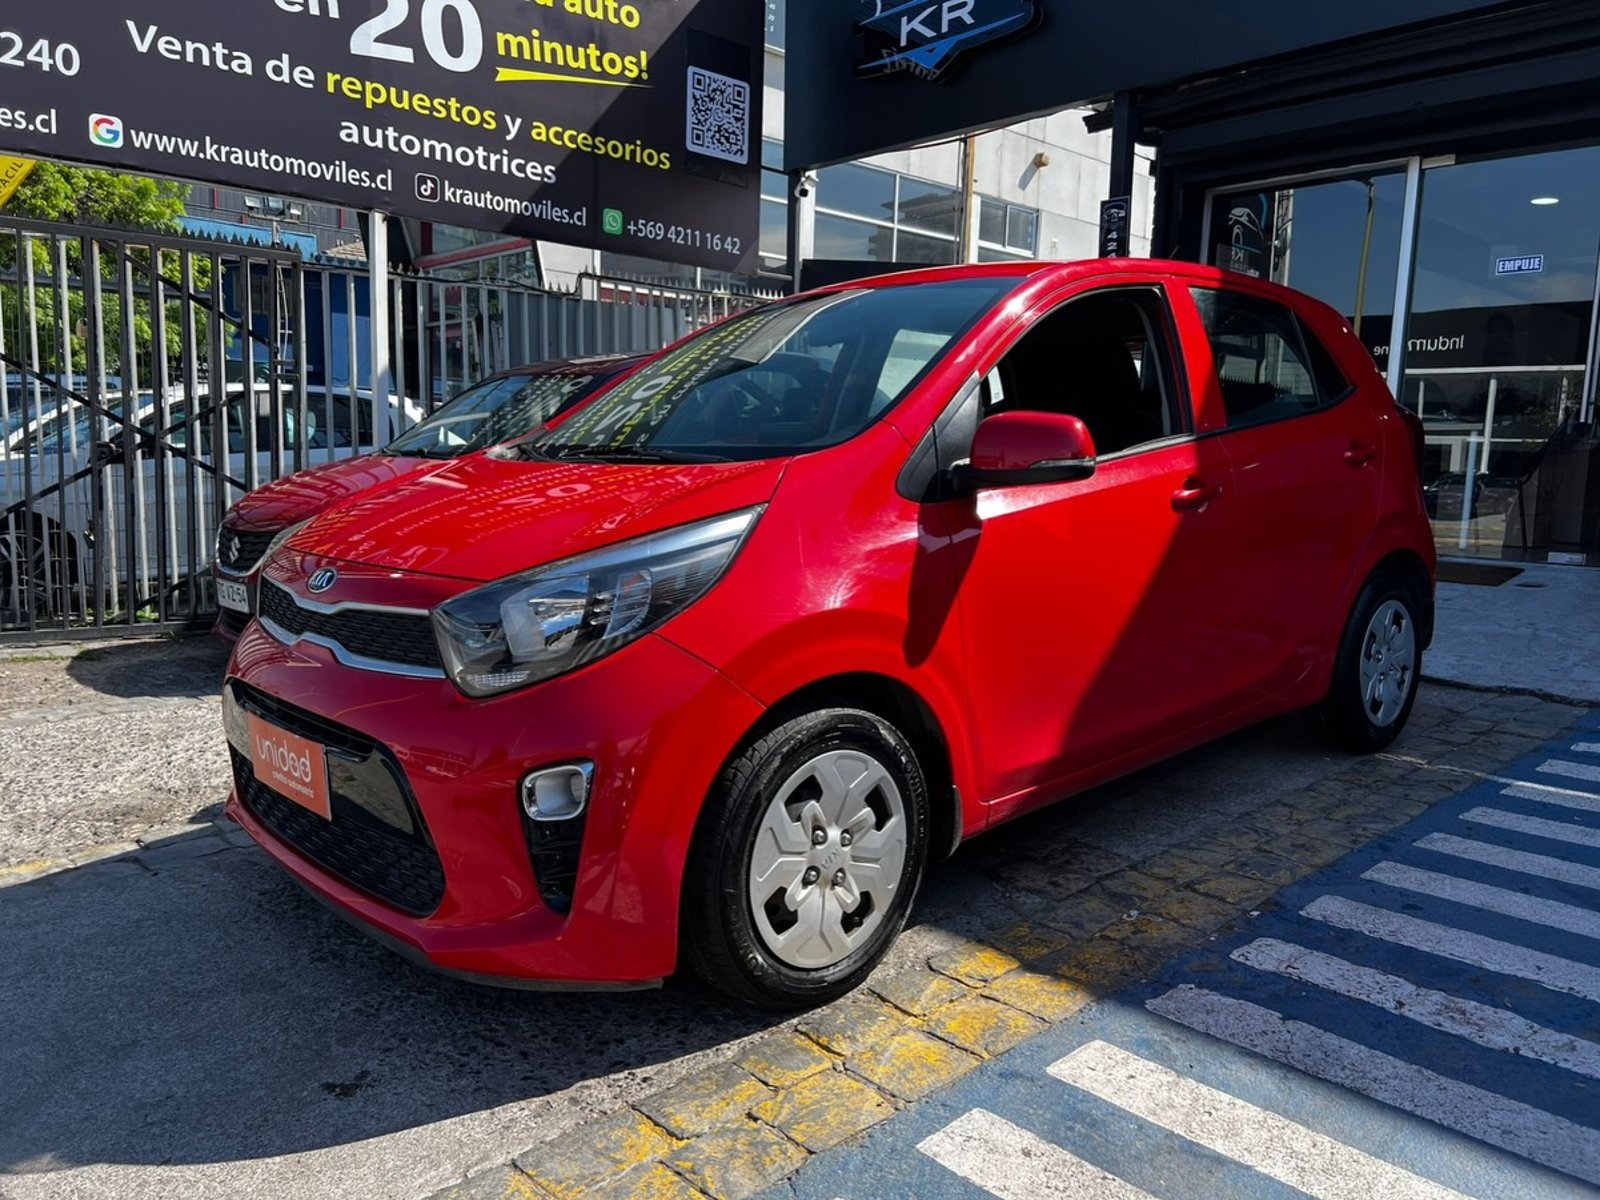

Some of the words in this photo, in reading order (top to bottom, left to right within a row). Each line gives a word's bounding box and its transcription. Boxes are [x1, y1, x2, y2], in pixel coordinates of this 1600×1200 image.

[350, 0, 483, 72] 20
[564, 0, 641, 28] auto
[899, 0, 975, 47] KR
[496, 29, 649, 80] minutos!
[126, 20, 252, 76] Venta
[265, 53, 315, 88] de
[326, 72, 497, 130] repuestos
[504, 112, 523, 140] y
[531, 118, 671, 170] accesorios
[130, 128, 392, 191] www.krautomoviles.cl
[340, 120, 557, 184] automotrices
[0, 161, 24, 193] ACIL
[444, 180, 587, 227] krautomoviles.cl
[627, 219, 664, 240] +569
[667, 225, 700, 247] 4211
[1499, 257, 1541, 272] EMPUJE
[256, 734, 311, 783] unidad
